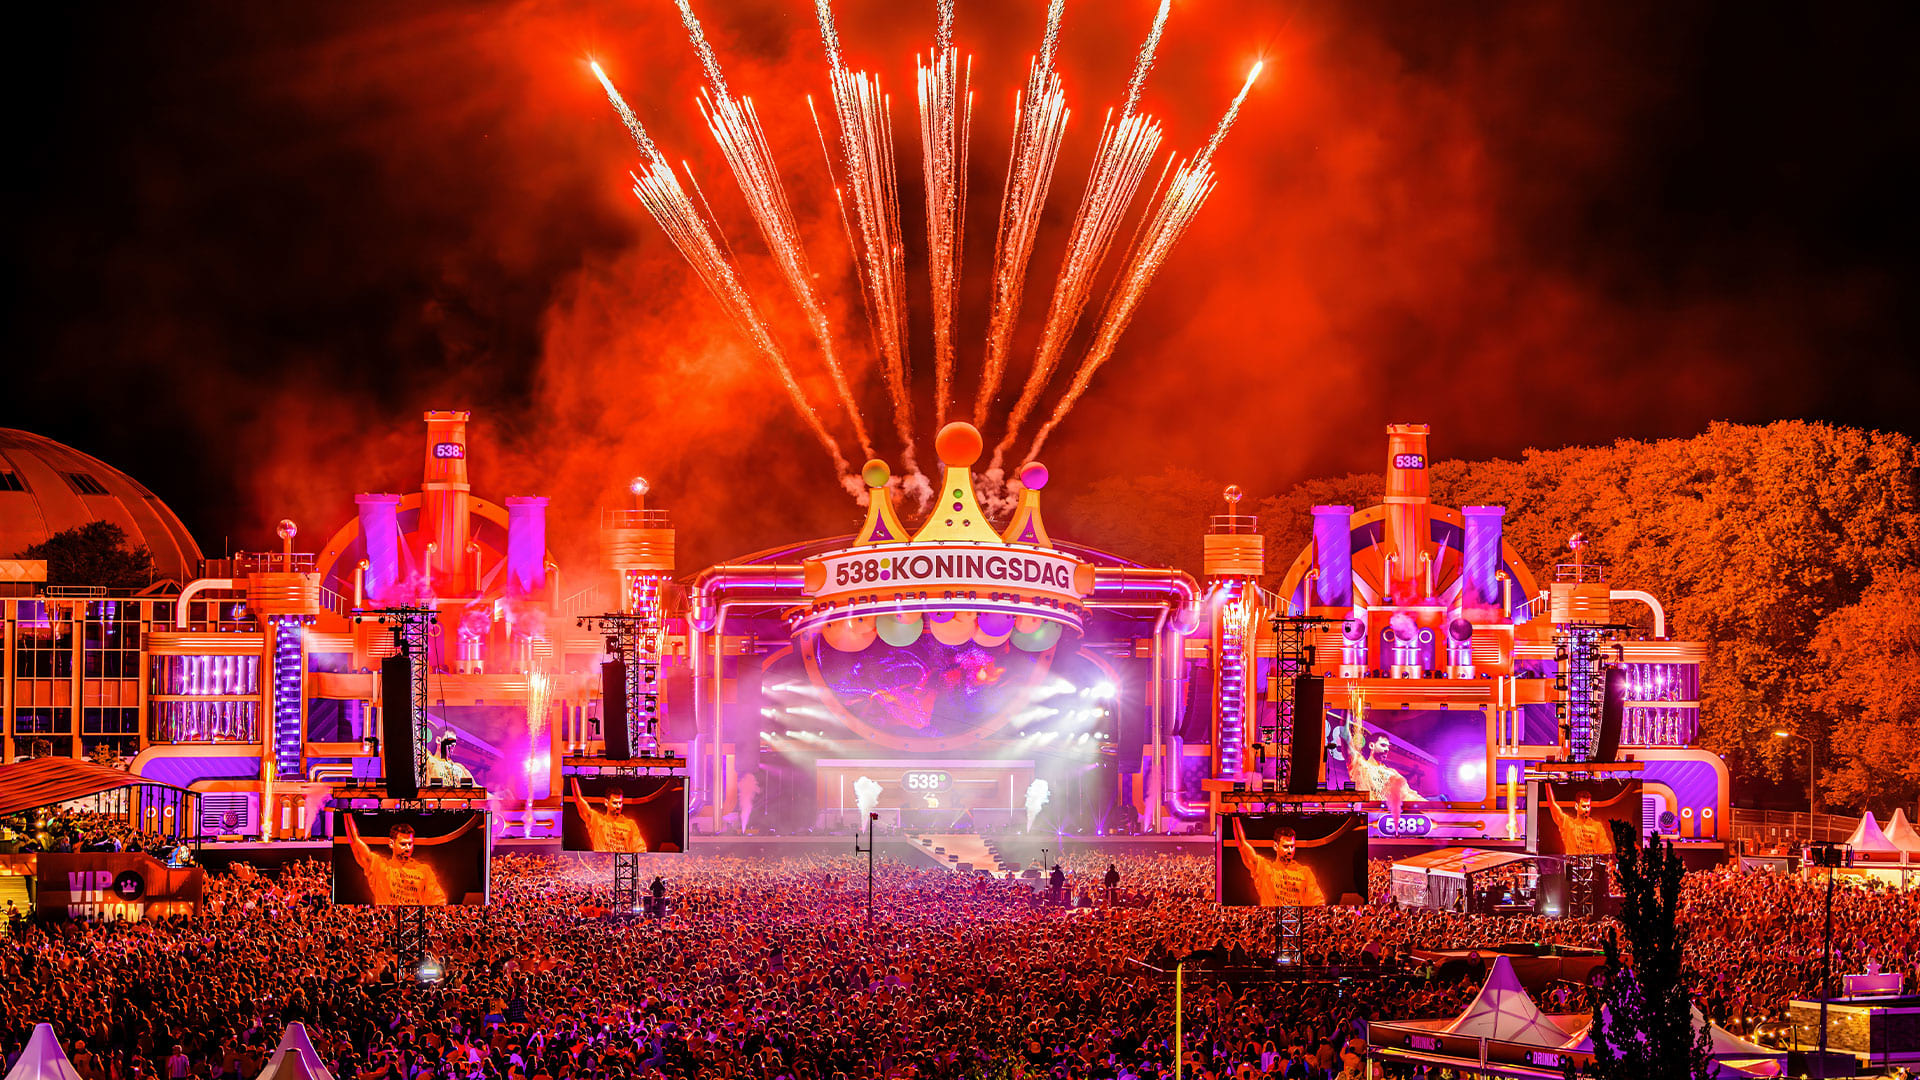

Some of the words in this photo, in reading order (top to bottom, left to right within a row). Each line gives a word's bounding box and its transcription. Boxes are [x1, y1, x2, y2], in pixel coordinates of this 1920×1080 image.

[436, 444, 460, 457] 538
[1396, 455, 1419, 468] 538
[891, 555, 1070, 589] KONINGSDAG
[908, 774, 939, 789] 538
[1385, 817, 1417, 833] 538
[68, 870, 113, 903] VIP
[1533, 1051, 1559, 1067] DRINKS
